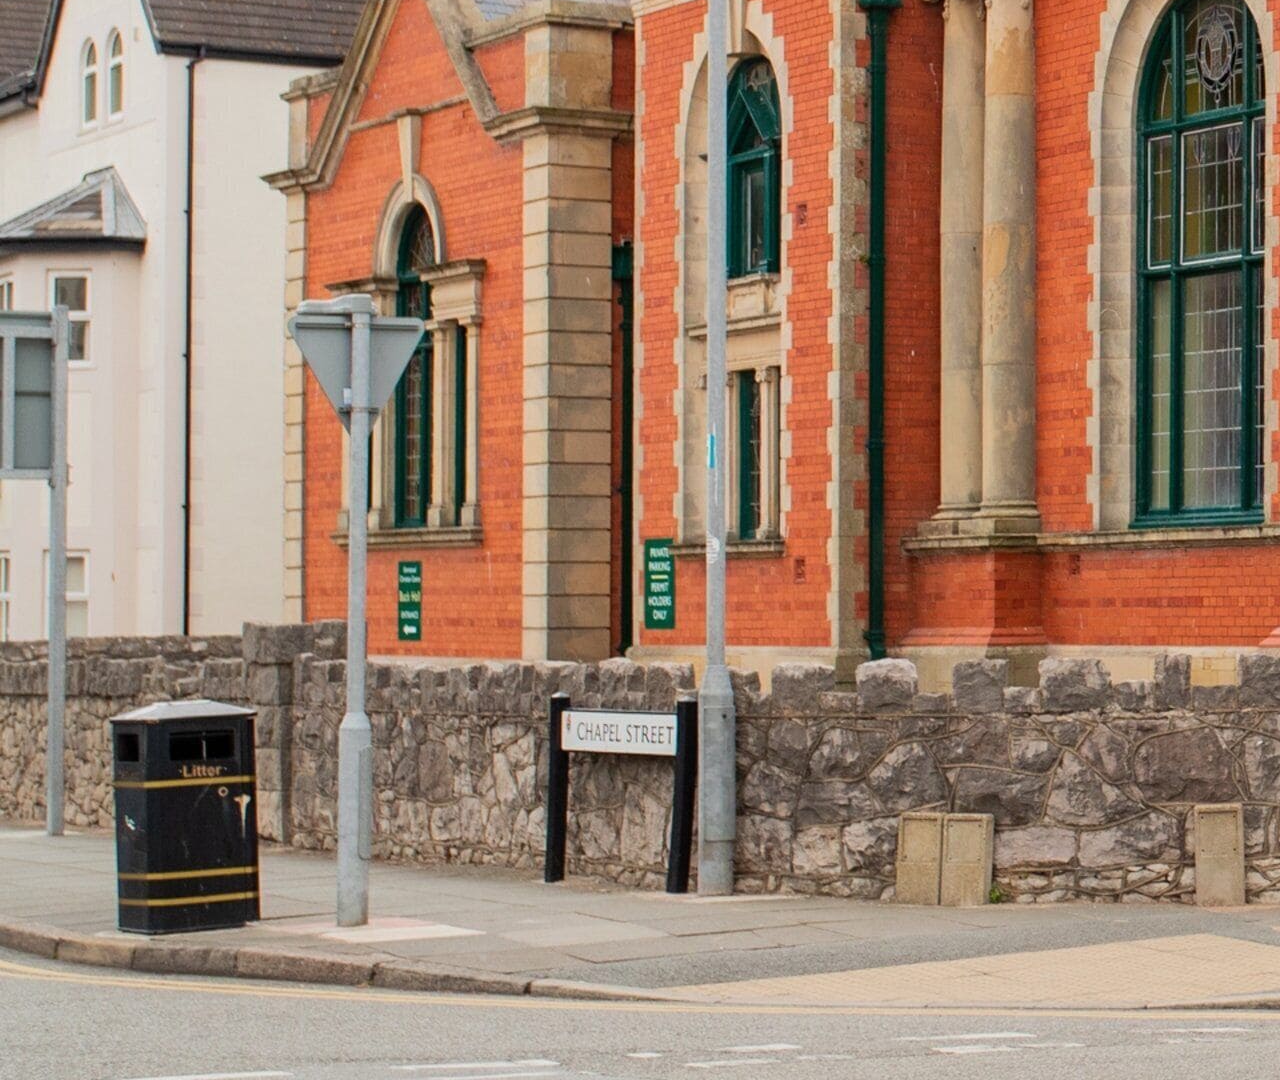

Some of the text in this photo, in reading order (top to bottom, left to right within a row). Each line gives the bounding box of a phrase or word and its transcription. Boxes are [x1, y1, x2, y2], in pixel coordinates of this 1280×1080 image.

[577, 722, 674, 744] CHAPEL STREET
[182, 764, 221, 777] Litter
